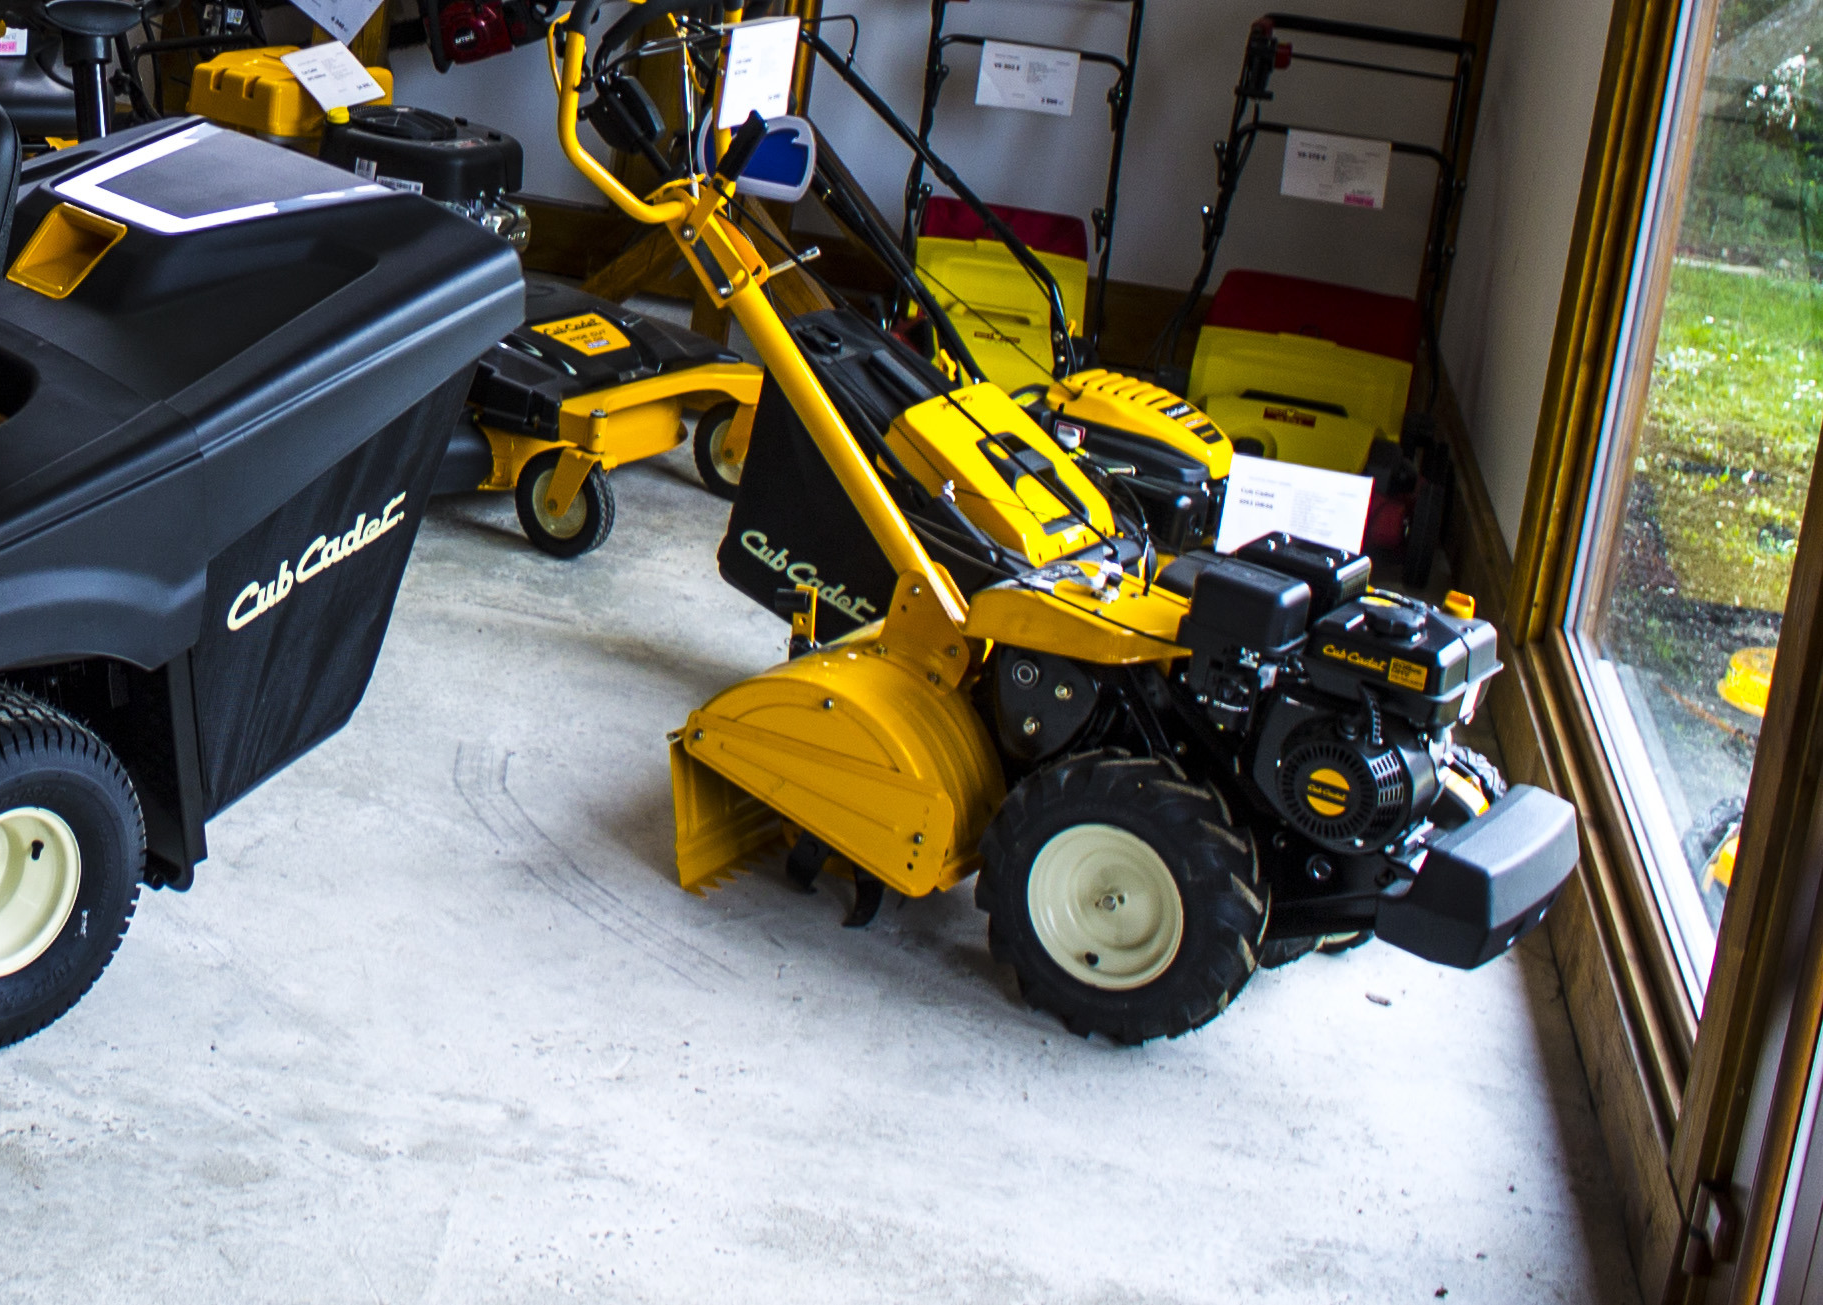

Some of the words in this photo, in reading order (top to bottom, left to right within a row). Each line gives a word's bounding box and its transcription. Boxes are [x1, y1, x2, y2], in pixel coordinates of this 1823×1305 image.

[227, 559, 294, 631] Cub
[295, 491, 407, 584] Cadet
[741, 529, 789, 572] Cub
[787, 562, 877, 623] Cadet
[1322, 644, 1347, 661] Cub
[1347, 651, 1388, 673] Cadet
